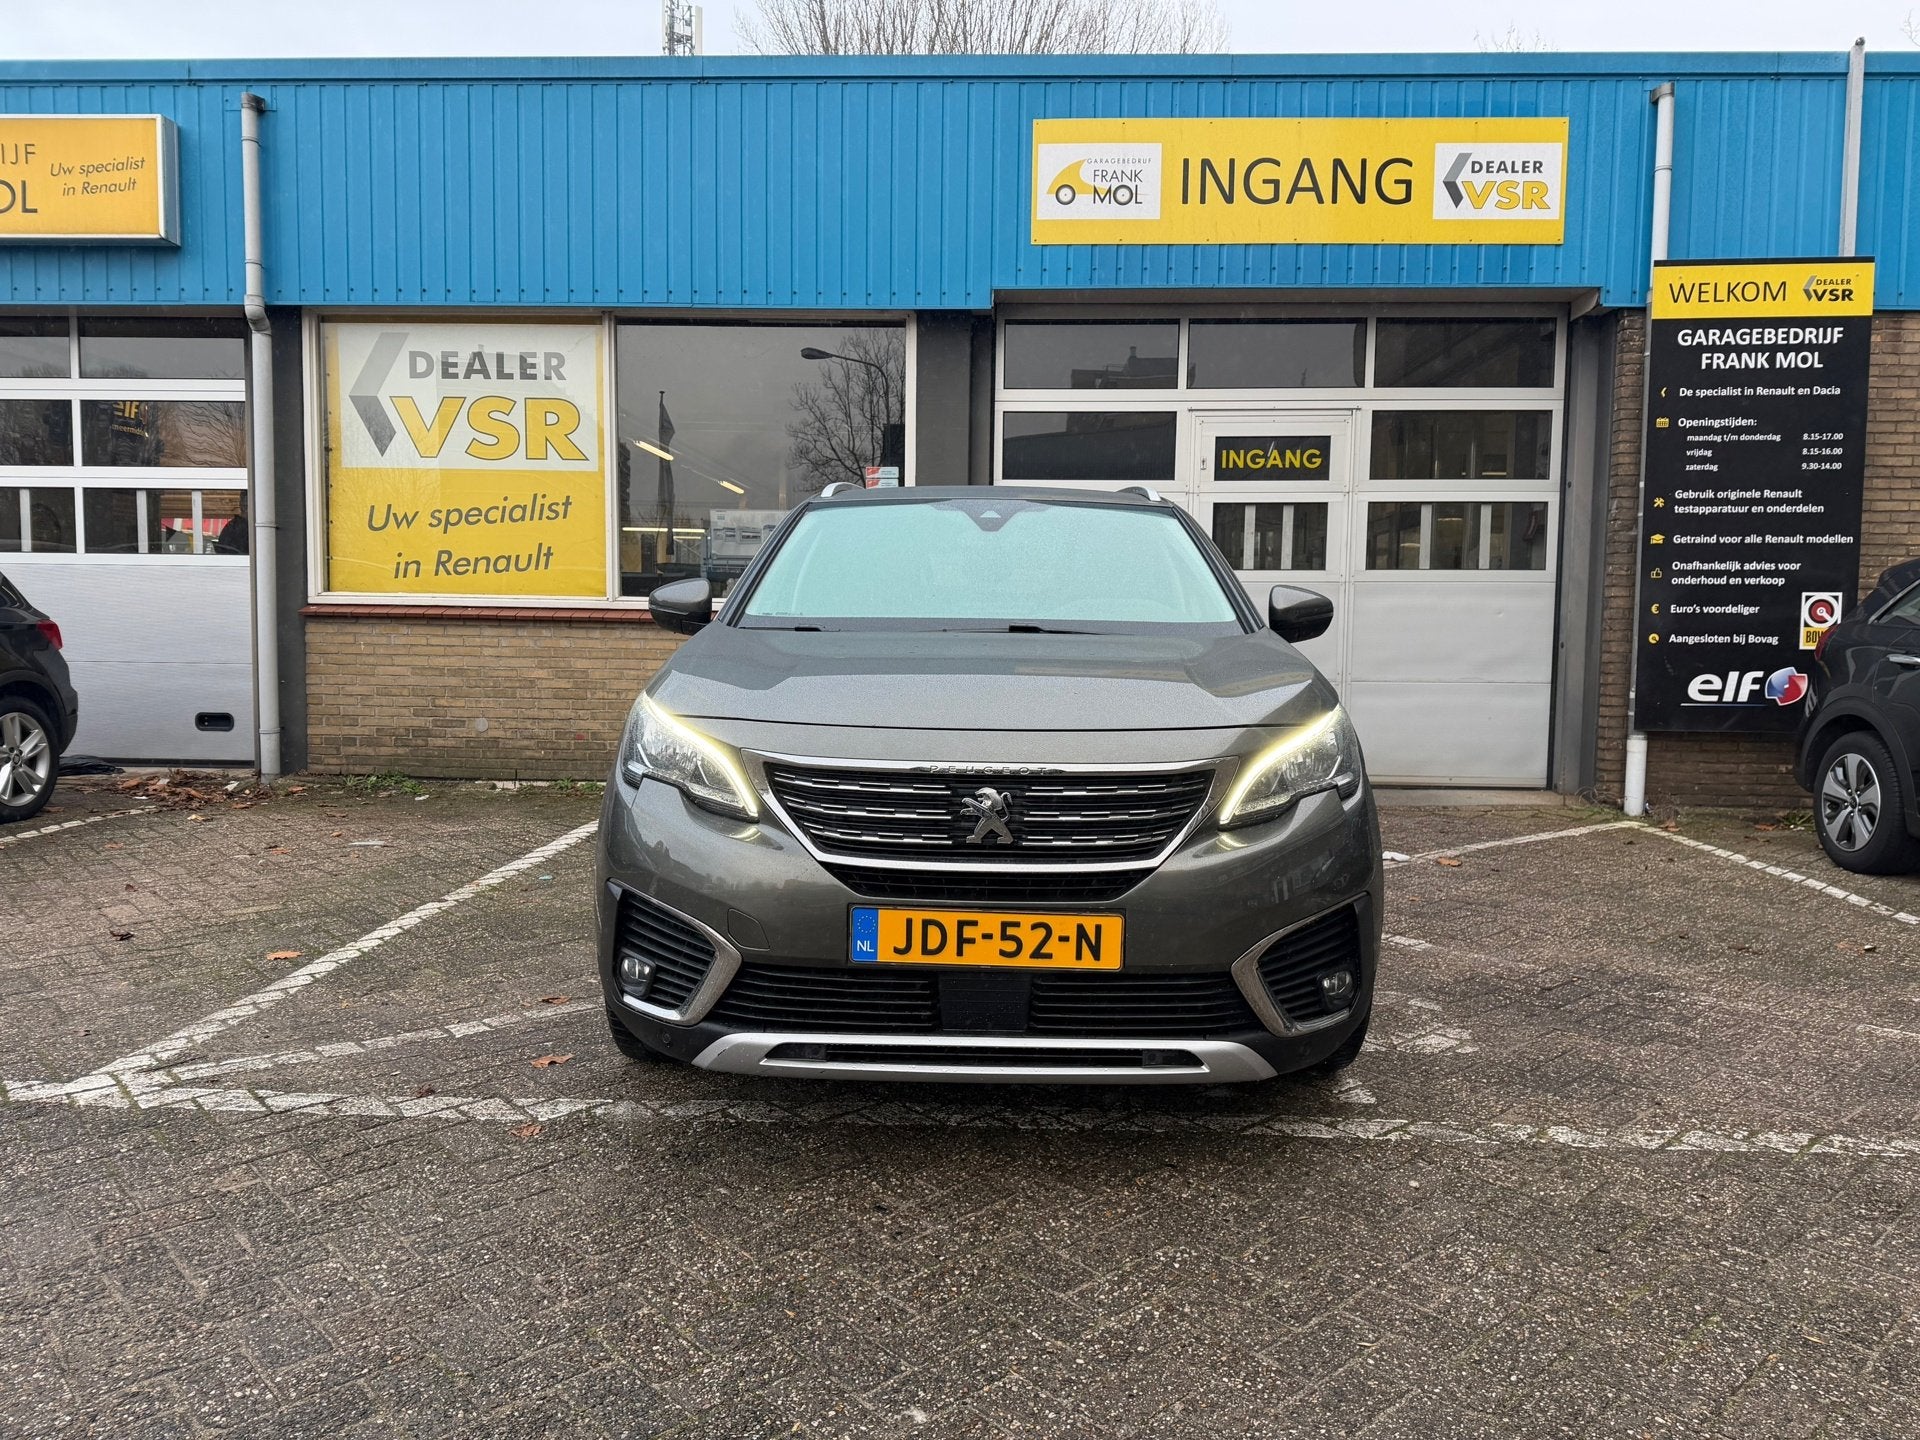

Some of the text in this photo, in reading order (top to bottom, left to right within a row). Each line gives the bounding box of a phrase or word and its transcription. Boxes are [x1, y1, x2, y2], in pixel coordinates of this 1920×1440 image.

[50, 156, 146, 178] Uw specialist
[1470, 160, 1544, 174] DEALER
[1093, 169, 1143, 182] FRANK
[1181, 157, 1413, 205] INGANG
[62, 177, 137, 197] in Renault
[1092, 184, 1143, 206] MOL
[1462, 179, 1551, 210] VSR
[1816, 278, 1852, 286] DEALER
[1669, 281, 1787, 303] WELKOM
[1812, 288, 1854, 301] VSR
[1677, 327, 1844, 347] GARAGEBEDRIJF
[408, 350, 567, 381] DEALER
[1701, 351, 1824, 369] FRANK MOL
[1679, 385, 1841, 398] De specialist in Renault en Dacia
[389, 395, 589, 462] VSR
[1678, 416, 1757, 428] Openingstijden:
[1686, 433, 1844, 443] maandag t/m donderdag 8.15-17.00
[1686, 447, 1843, 457] vrijdag 8.15-16.00
[1221, 449, 1322, 469] INGANG
[1685, 462, 1843, 472] zaterdag 9.30-14.00
[1674, 489, 1803, 500] Gebruik originele Renault
[367, 492, 572, 534] Uw specialist
[1674, 503, 1825, 515] testapparatuur en onderdelen
[1673, 534, 1854, 544] Getraind voor alle Renault modellen
[393, 542, 554, 579] in Renault
[1671, 560, 1802, 573] Onafhankelijk advies voor
[1671, 575, 1786, 587] onderhoud en verkoop
[1702, 604, 1760, 616] voordeliger
[1669, 633, 1779, 646] Aangesloten bij Bovag
[1687, 671, 1765, 702] elf
[929, 765, 1047, 775] PEUGEOT
[856, 940, 874, 952] NL
[893, 917, 1102, 962] JDF-52-N
